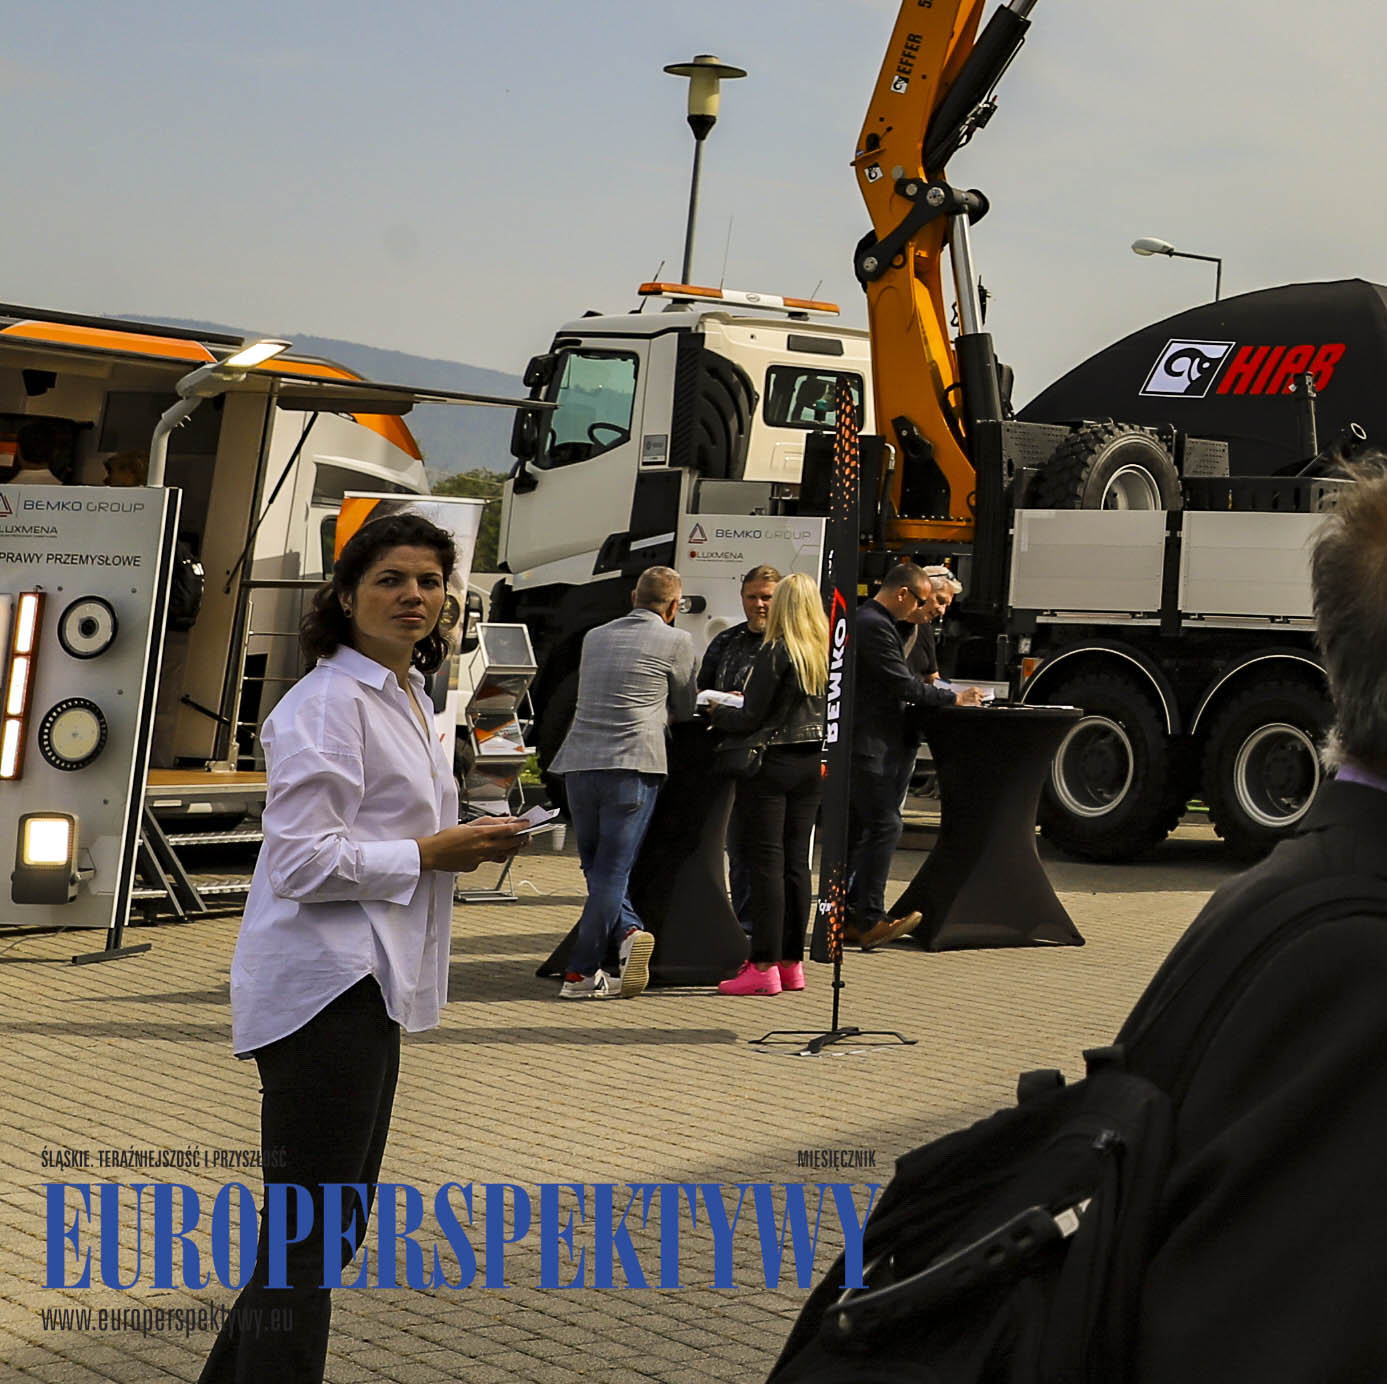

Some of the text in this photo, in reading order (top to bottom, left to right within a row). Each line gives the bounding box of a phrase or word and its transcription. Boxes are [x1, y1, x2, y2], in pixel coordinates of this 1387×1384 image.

[897, 33, 922, 75] EFFER
[1215, 343, 1347, 395] HIAB
[23, 499, 145, 513] BEMKO GROUP
[715, 528, 762, 539] BEMKO
[46, 552, 142, 567] PRZEMYSŁOWE
[827, 617, 847, 744] BEMKO
